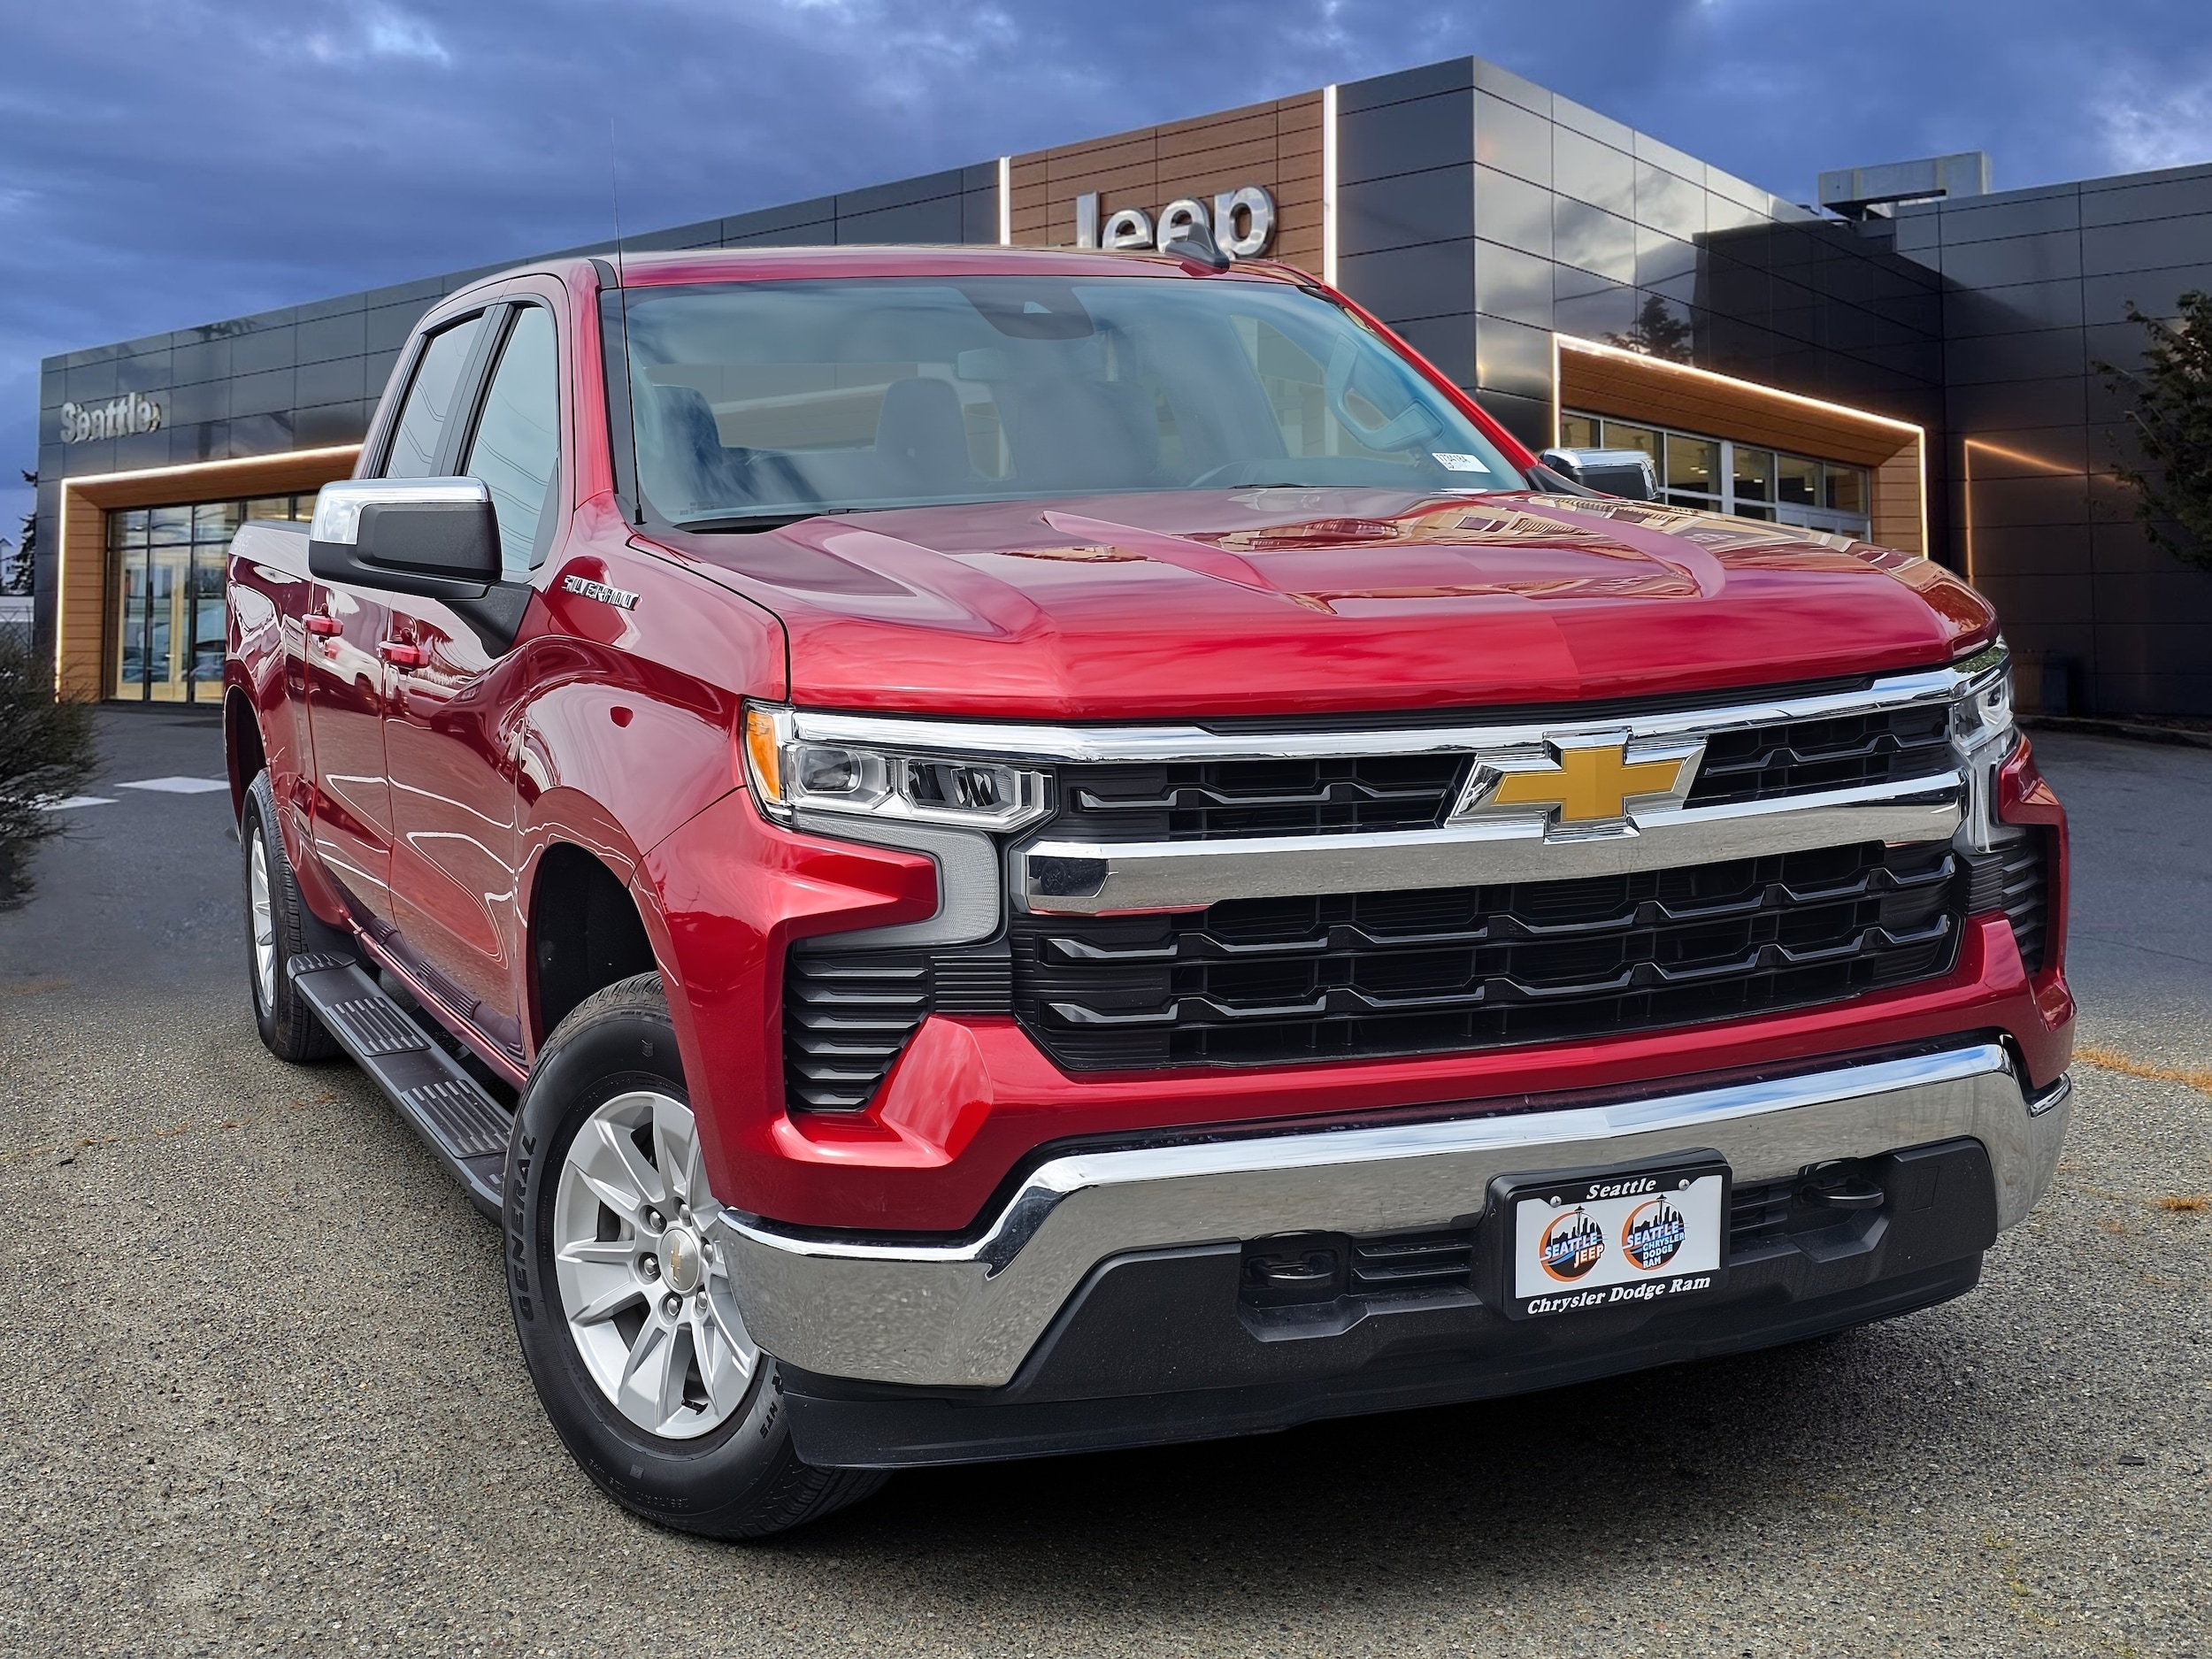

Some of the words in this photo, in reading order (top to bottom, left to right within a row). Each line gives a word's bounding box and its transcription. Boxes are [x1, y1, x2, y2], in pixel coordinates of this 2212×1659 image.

[60, 392, 156, 443] Seattle
[1586, 1178, 1656, 1200] Seattle
[511, 1135, 537, 1320] GENERAL
[1627, 1220, 1679, 1248] SEATTLE
[1545, 1232, 1598, 1259] SEATTLE
[1642, 1232, 1685, 1252] CHRYSLER
[1642, 1243, 1673, 1261] DODGE
[1573, 1244, 1604, 1269] JEEP
[1642, 1256, 1662, 1269] RAM
[1527, 1292, 1606, 1315] Chrysler
[1609, 1283, 1666, 1301] Dodge
[1669, 1276, 1711, 1294] Ram
